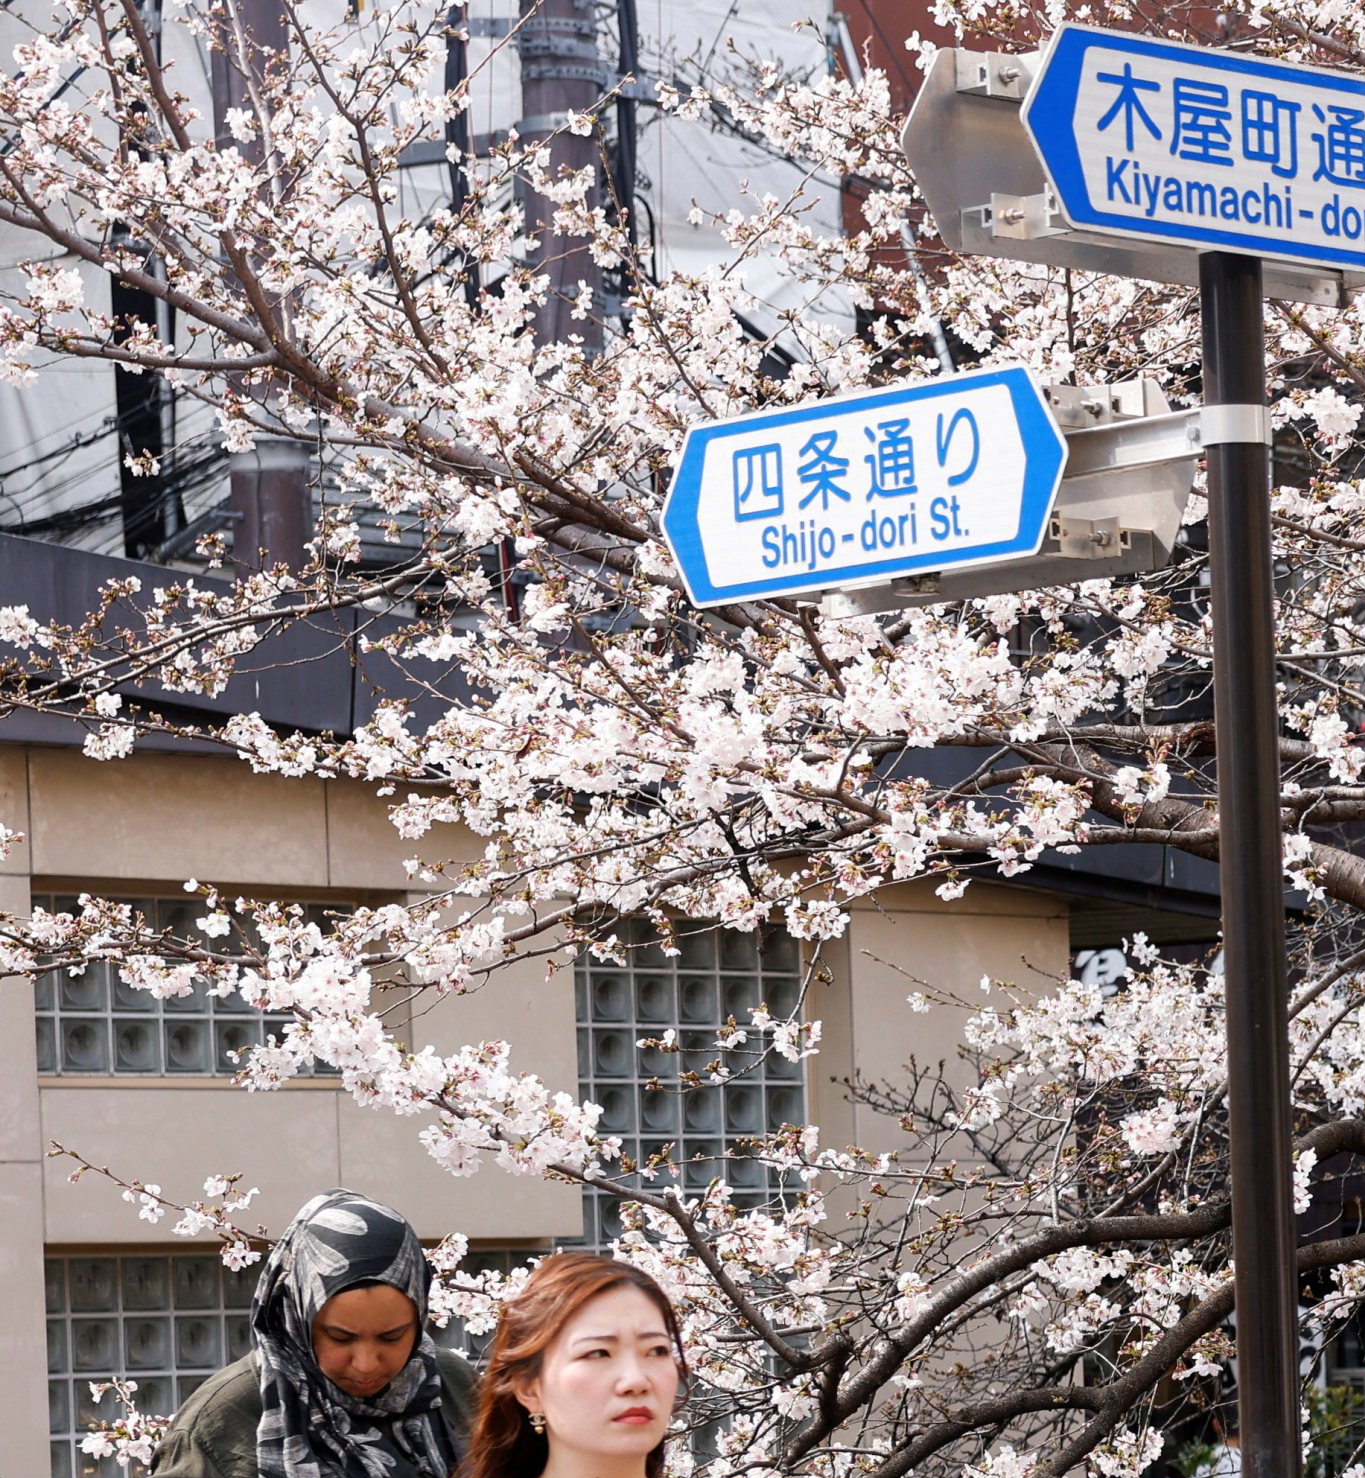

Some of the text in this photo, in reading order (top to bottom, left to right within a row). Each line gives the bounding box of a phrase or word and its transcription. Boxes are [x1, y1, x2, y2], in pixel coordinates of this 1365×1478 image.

[732, 407, 981, 523] 四条通り
[761, 495, 970, 571] Shijo-dori St.
